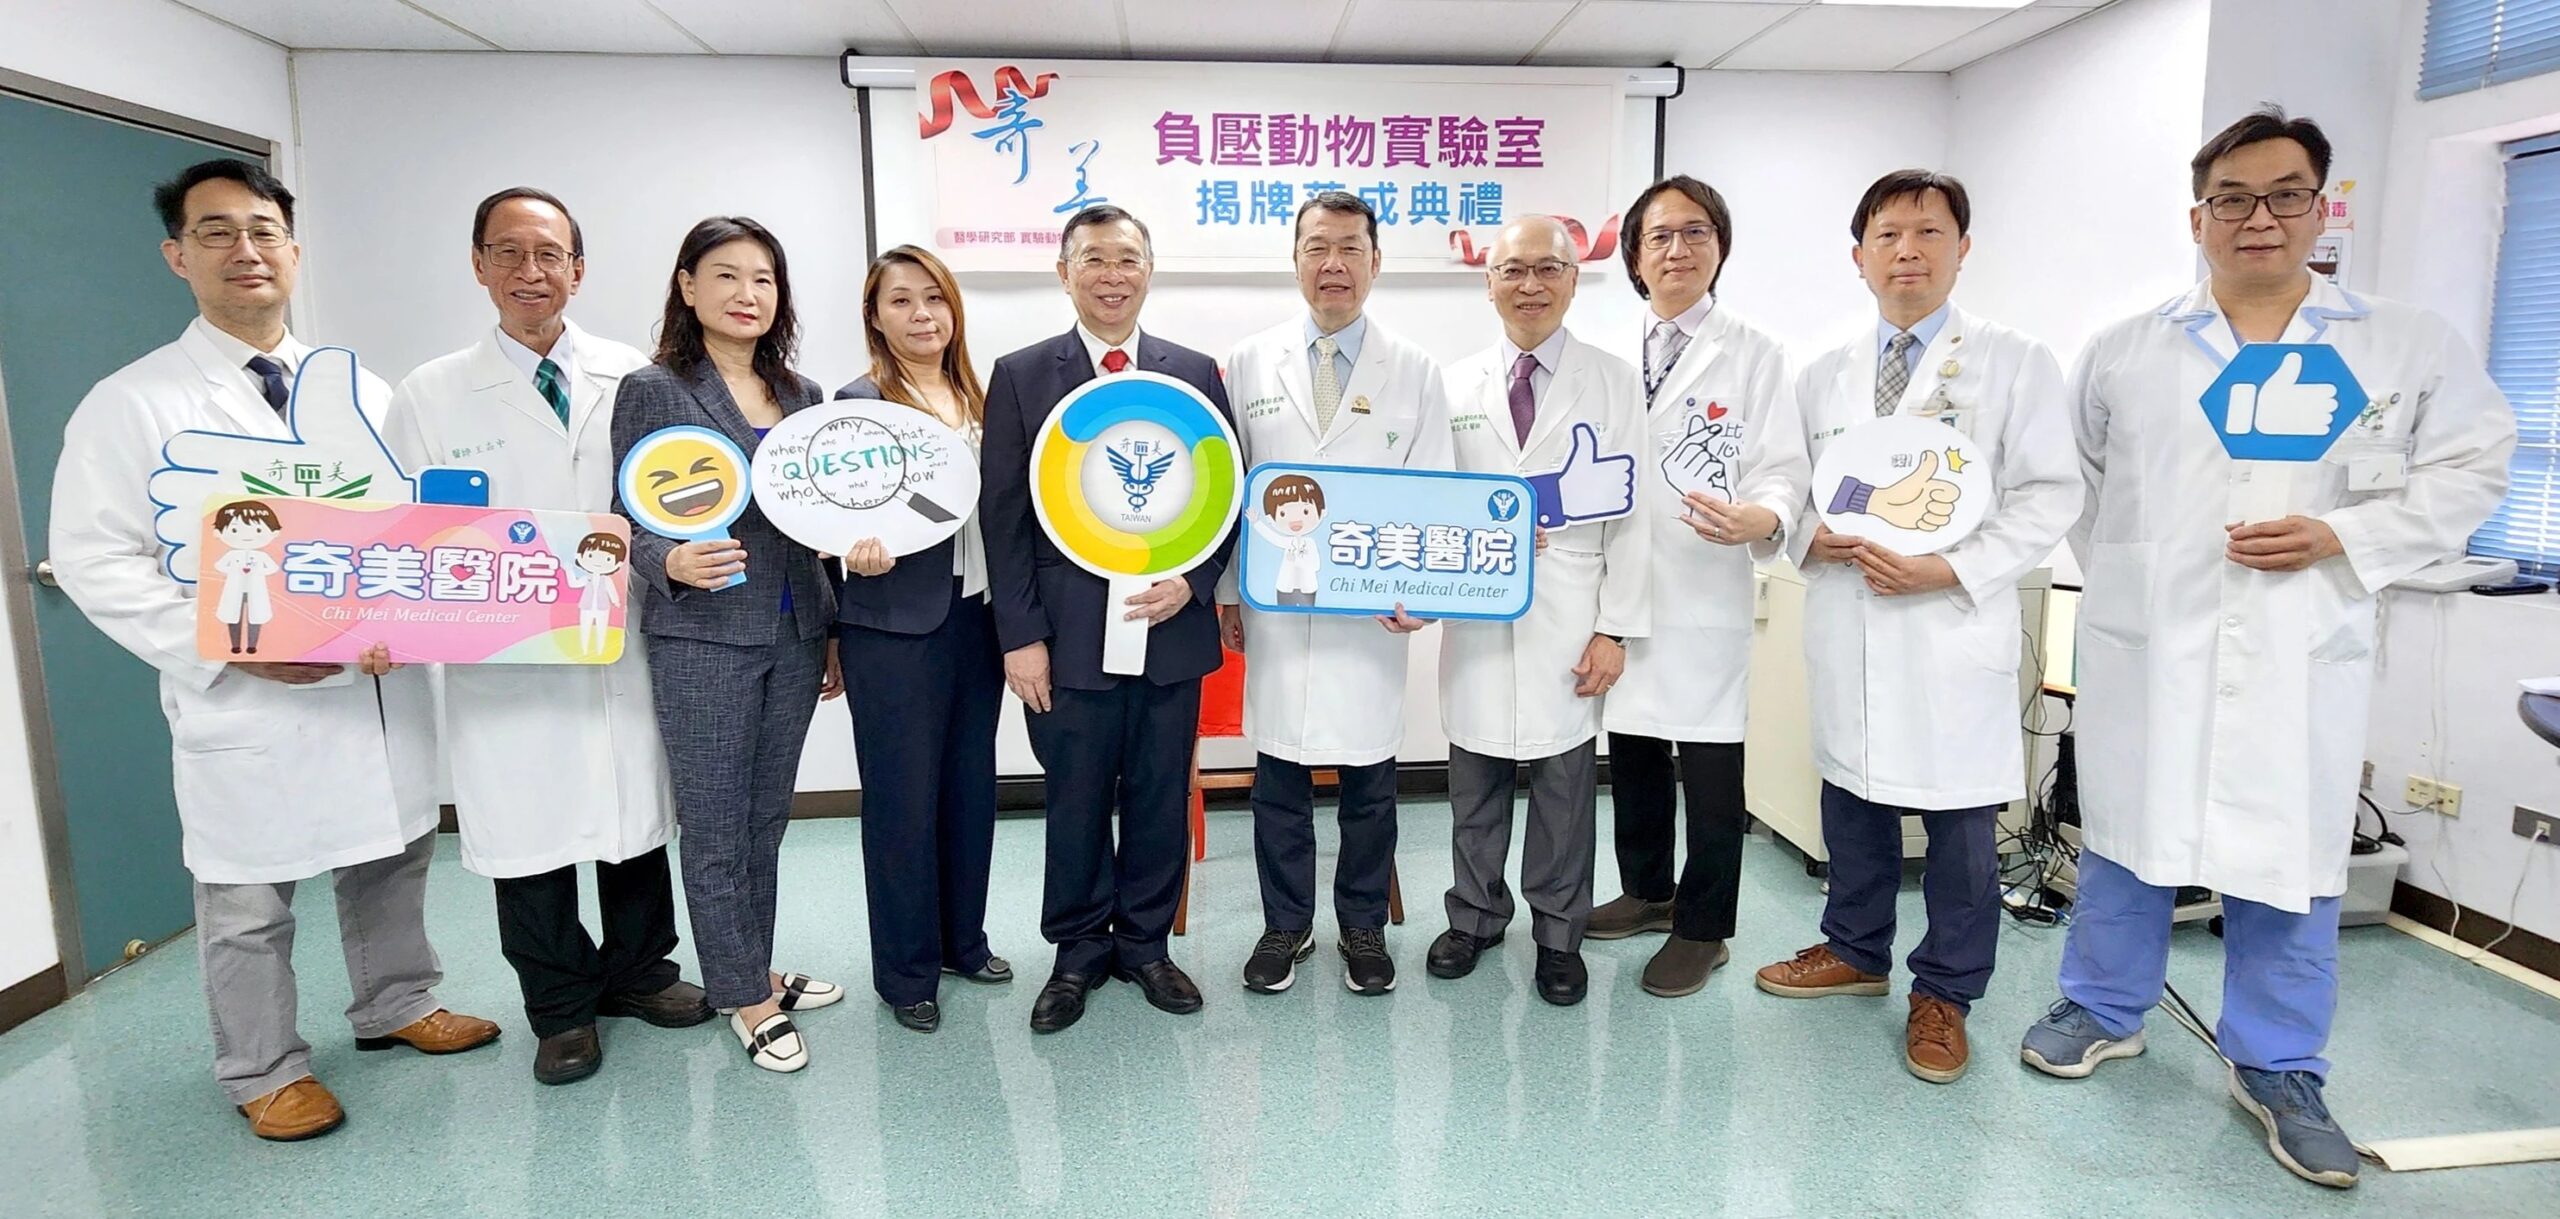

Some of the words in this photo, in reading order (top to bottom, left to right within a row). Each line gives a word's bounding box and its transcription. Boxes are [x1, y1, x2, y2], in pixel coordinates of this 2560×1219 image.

[1153, 111, 1545, 168] 負壓動物實驗室
[1020, 231, 1063, 244] 實驗動
[828, 420, 863, 433] why
[768, 444, 806, 457] when
[783, 442, 935, 480] QUESTIONS
[265, 459, 288, 481] 奇
[327, 461, 349, 483] 美
[777, 484, 814, 501] who
[1120, 513, 1152, 524] TAIWAN
[1328, 521, 1517, 575] 奇美醫院
[284, 540, 561, 603] 奇美醫院
[1329, 577, 1355, 592] Chi
[1359, 578, 1389, 593] Mei
[1392, 580, 1455, 596] Medical
[1458, 583, 1510, 598] Center
[322, 606, 352, 620] Chi
[356, 607, 389, 622] Mei
[398, 608, 462, 623] Medical
[465, 609, 521, 624] Center
